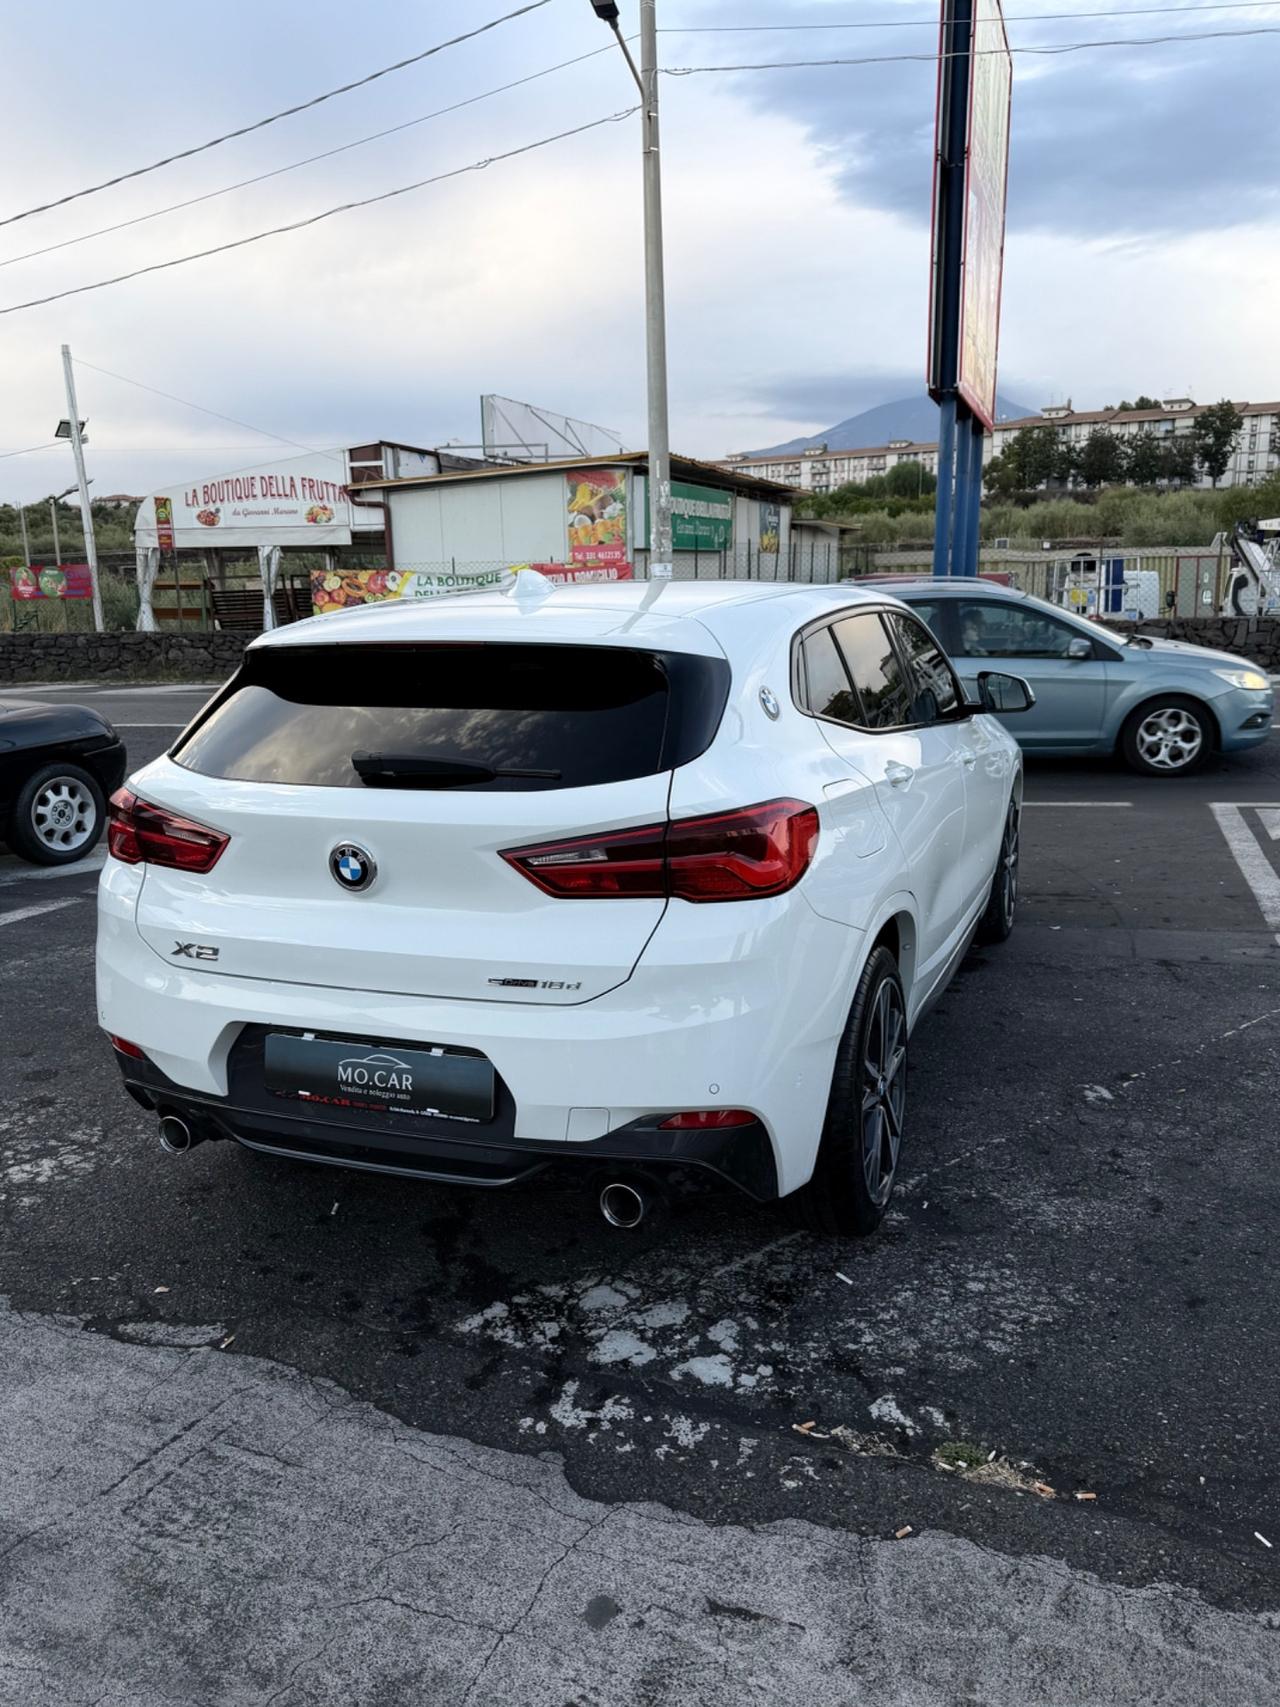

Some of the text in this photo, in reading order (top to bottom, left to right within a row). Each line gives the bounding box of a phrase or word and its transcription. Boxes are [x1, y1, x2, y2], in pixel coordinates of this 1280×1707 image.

[184, 488, 199, 508] LA
[202, 476, 257, 506] BOUTIQUE
[260, 475, 299, 499] DELLA
[416, 572, 502, 587] LA BOUTIQUE
[170, 940, 220, 962] X2
[337, 1065, 413, 1091] MO.CAR
[340, 1083, 363, 1095] Vendita
